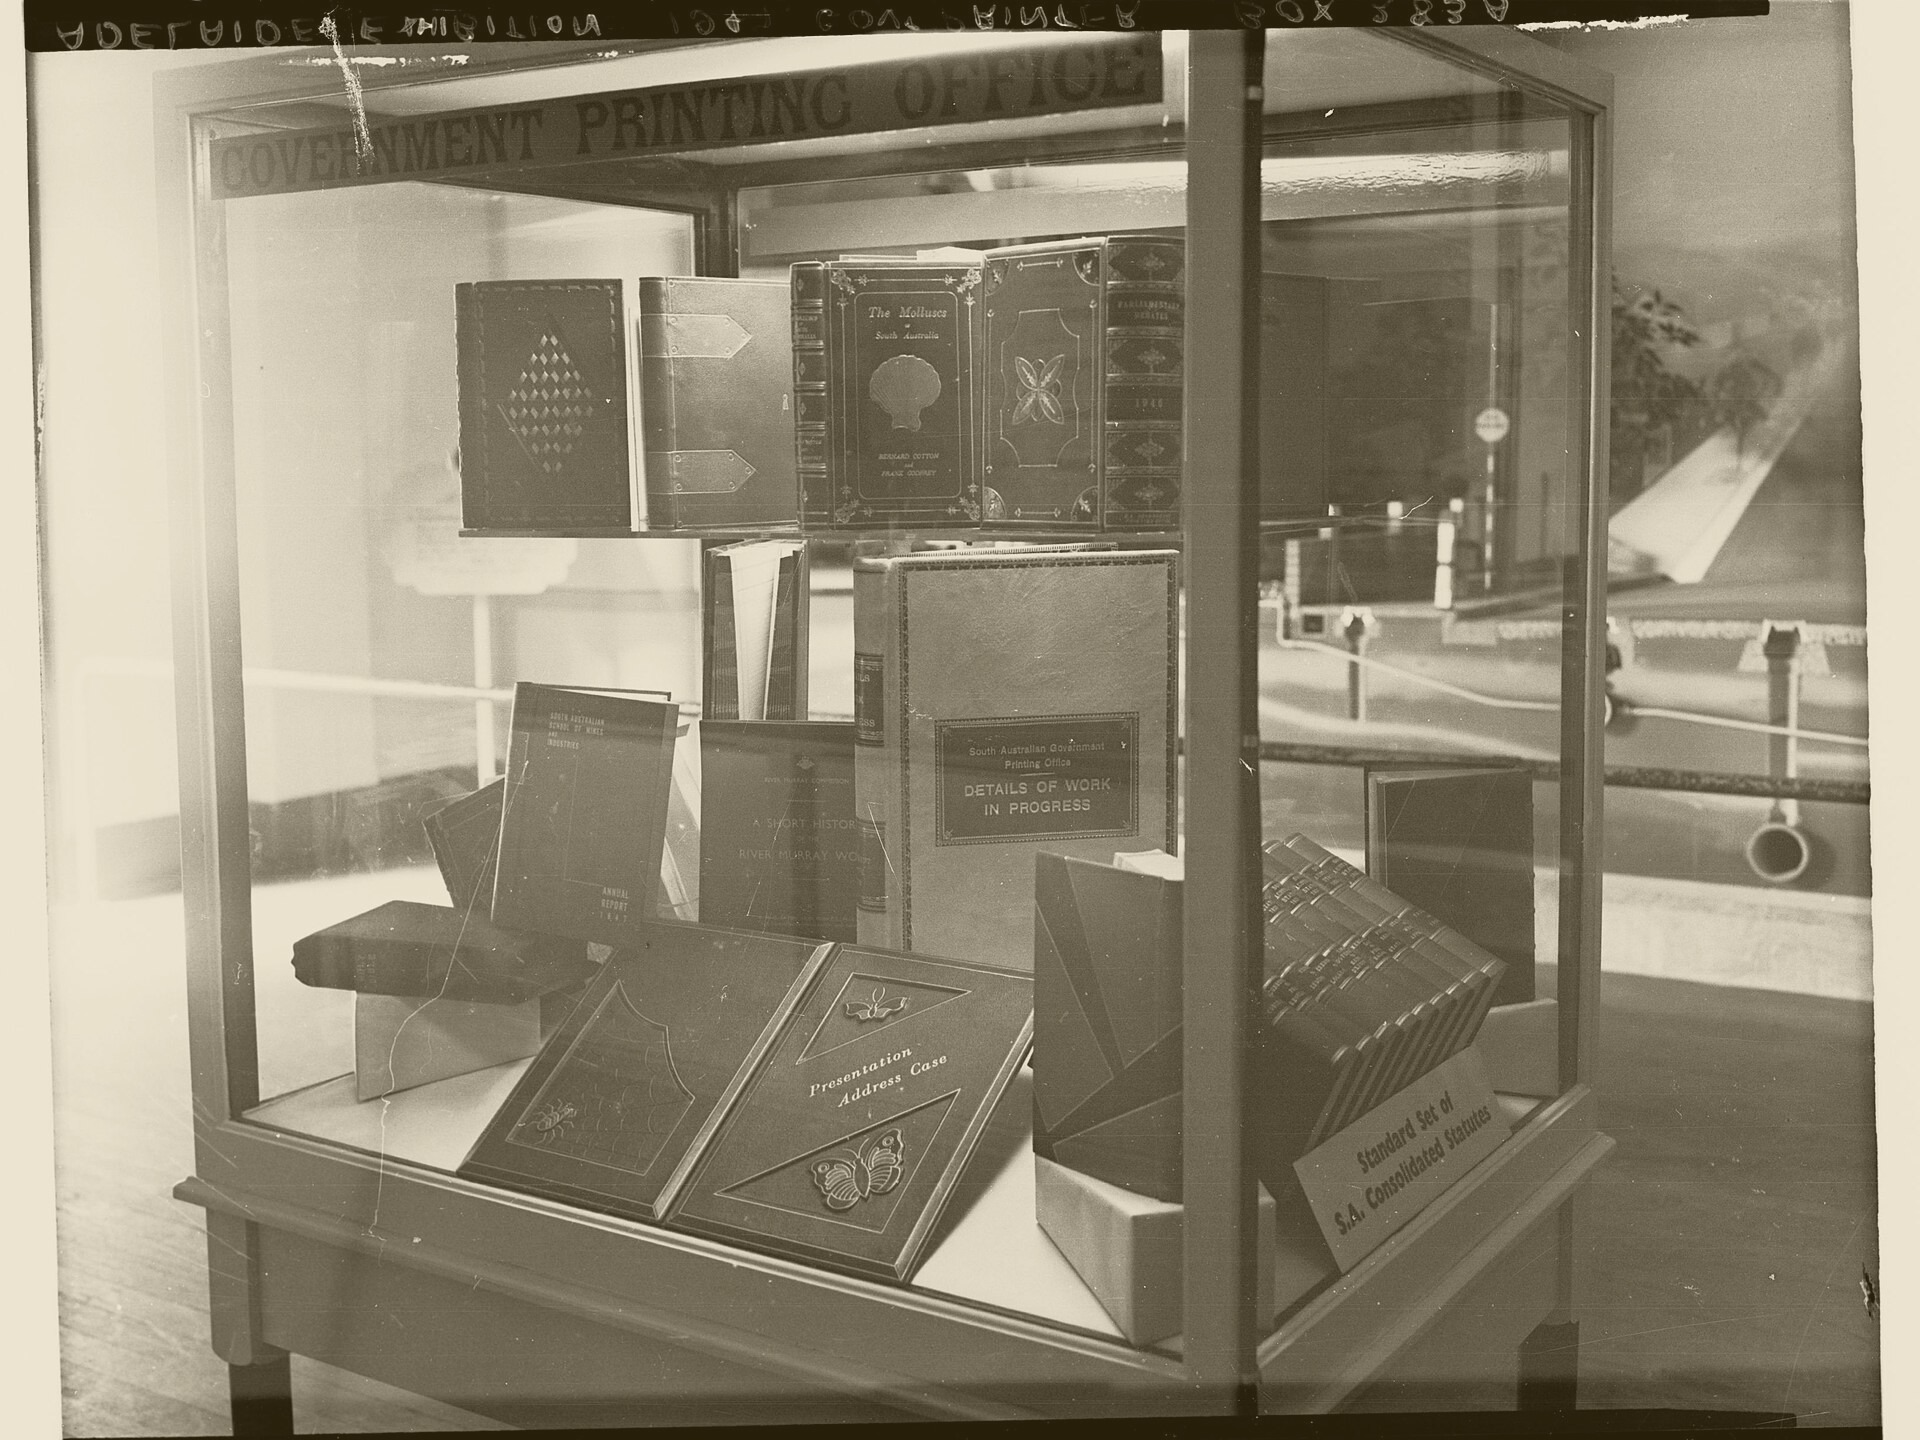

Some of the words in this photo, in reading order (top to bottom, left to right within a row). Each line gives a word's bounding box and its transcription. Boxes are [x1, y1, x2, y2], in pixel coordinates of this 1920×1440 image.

[220, 108, 544, 192] GOVERNMENT
[575, 73, 852, 155] PRINTING
[894, 36, 1147, 121] OFFICE
[868, 306, 891, 318] The
[899, 306, 947, 318] Molluscs
[875, 331, 898, 340] South
[903, 331, 939, 340] Australia
[969, 746, 996, 756] South
[1000, 744, 1046, 755] Australian
[1050, 741, 1105, 752] Government
[1004, 759, 1040, 770] Printing
[1044, 757, 1071, 768] Office
[964, 782, 1028, 797] DETAILS
[1036, 780, 1057, 793] OF
[1065, 777, 1111, 792] WORK
[984, 803, 1000, 816] IN
[1009, 799, 1091, 815] PROGRESS
[753, 819, 761, 828] A
[767, 818, 805, 829] SHORT
[813, 818, 858, 830] HISTOR
[739, 848, 771, 860] RIVER
[778, 849, 828, 861] MURRAY
[809, 1048, 912, 1097] Presentation
[838, 1074, 902, 1107] Address
[910, 1055, 948, 1076] Case
[1356, 1117, 1417, 1174] Standard
[1416, 1102, 1439, 1131] Set
[1440, 1090, 1454, 1115] of
[1334, 1203, 1366, 1235] S.A.
[1365, 1137, 1445, 1210] Consolidated
[1444, 1106, 1492, 1150] Statutes
